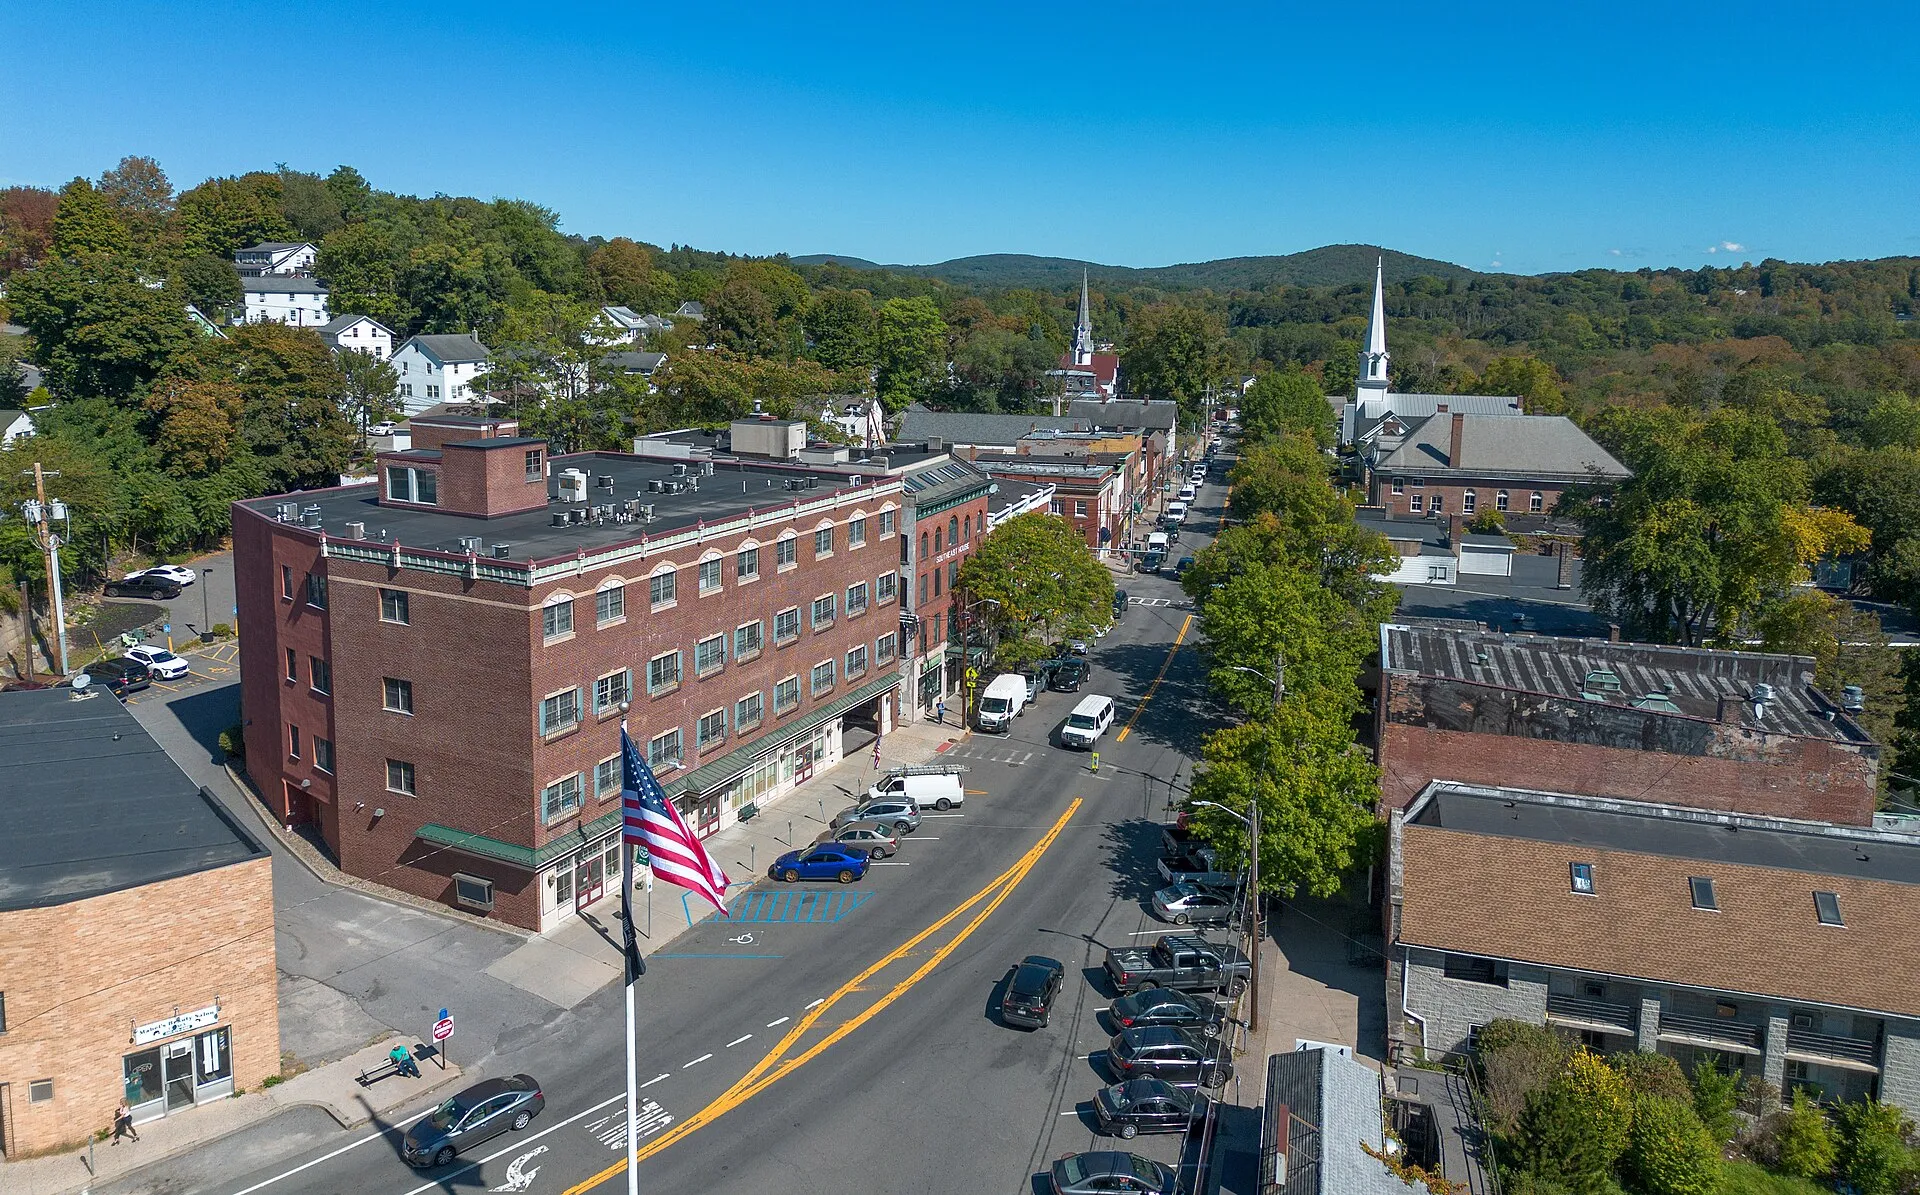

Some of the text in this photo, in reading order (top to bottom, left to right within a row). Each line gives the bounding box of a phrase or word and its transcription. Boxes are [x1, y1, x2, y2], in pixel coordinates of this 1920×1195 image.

[936, 542, 970, 563] SOUTHEAST HOUSE
[139, 1023, 166, 1034] Mabel's
[132, 1062, 153, 1075] OPEN
